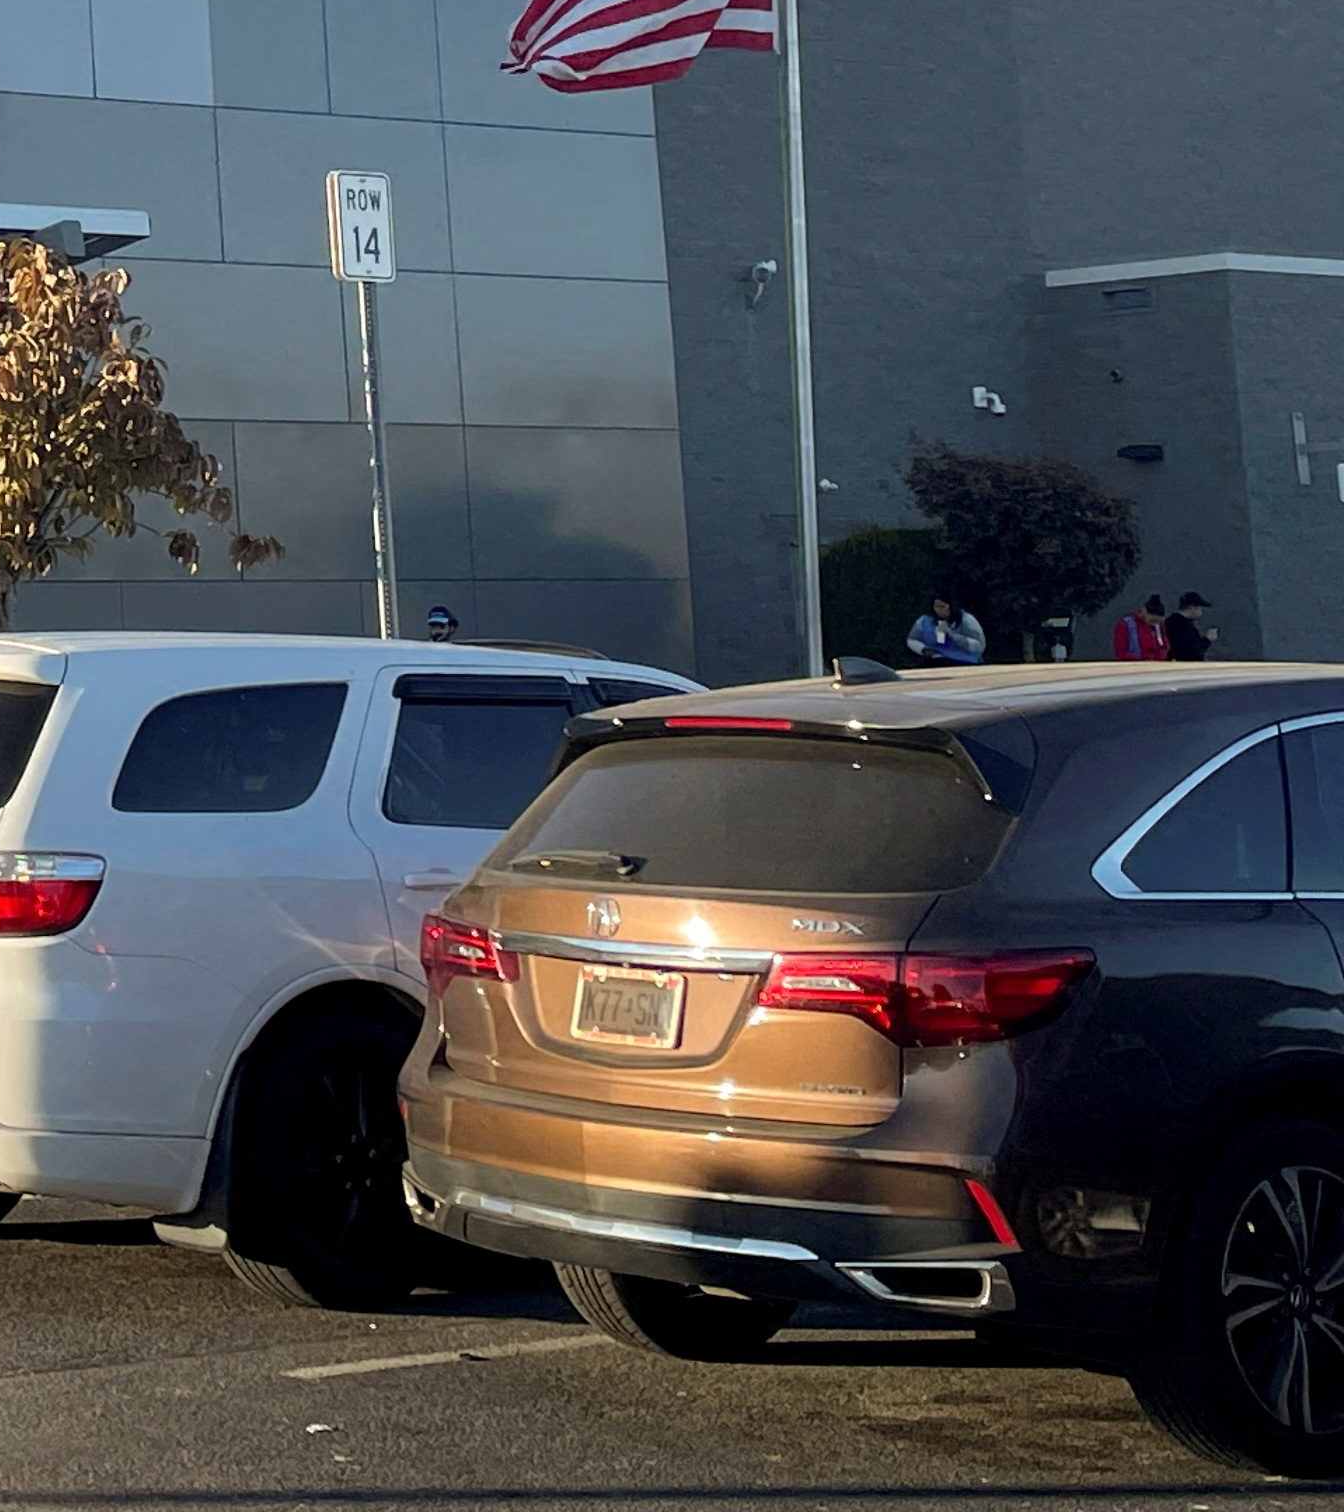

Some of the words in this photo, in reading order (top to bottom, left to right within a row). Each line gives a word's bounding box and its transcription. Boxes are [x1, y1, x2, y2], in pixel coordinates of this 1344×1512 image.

[346, 188, 381, 211] ROW
[353, 226, 380, 264] 14
[791, 918, 864, 937] MDX
